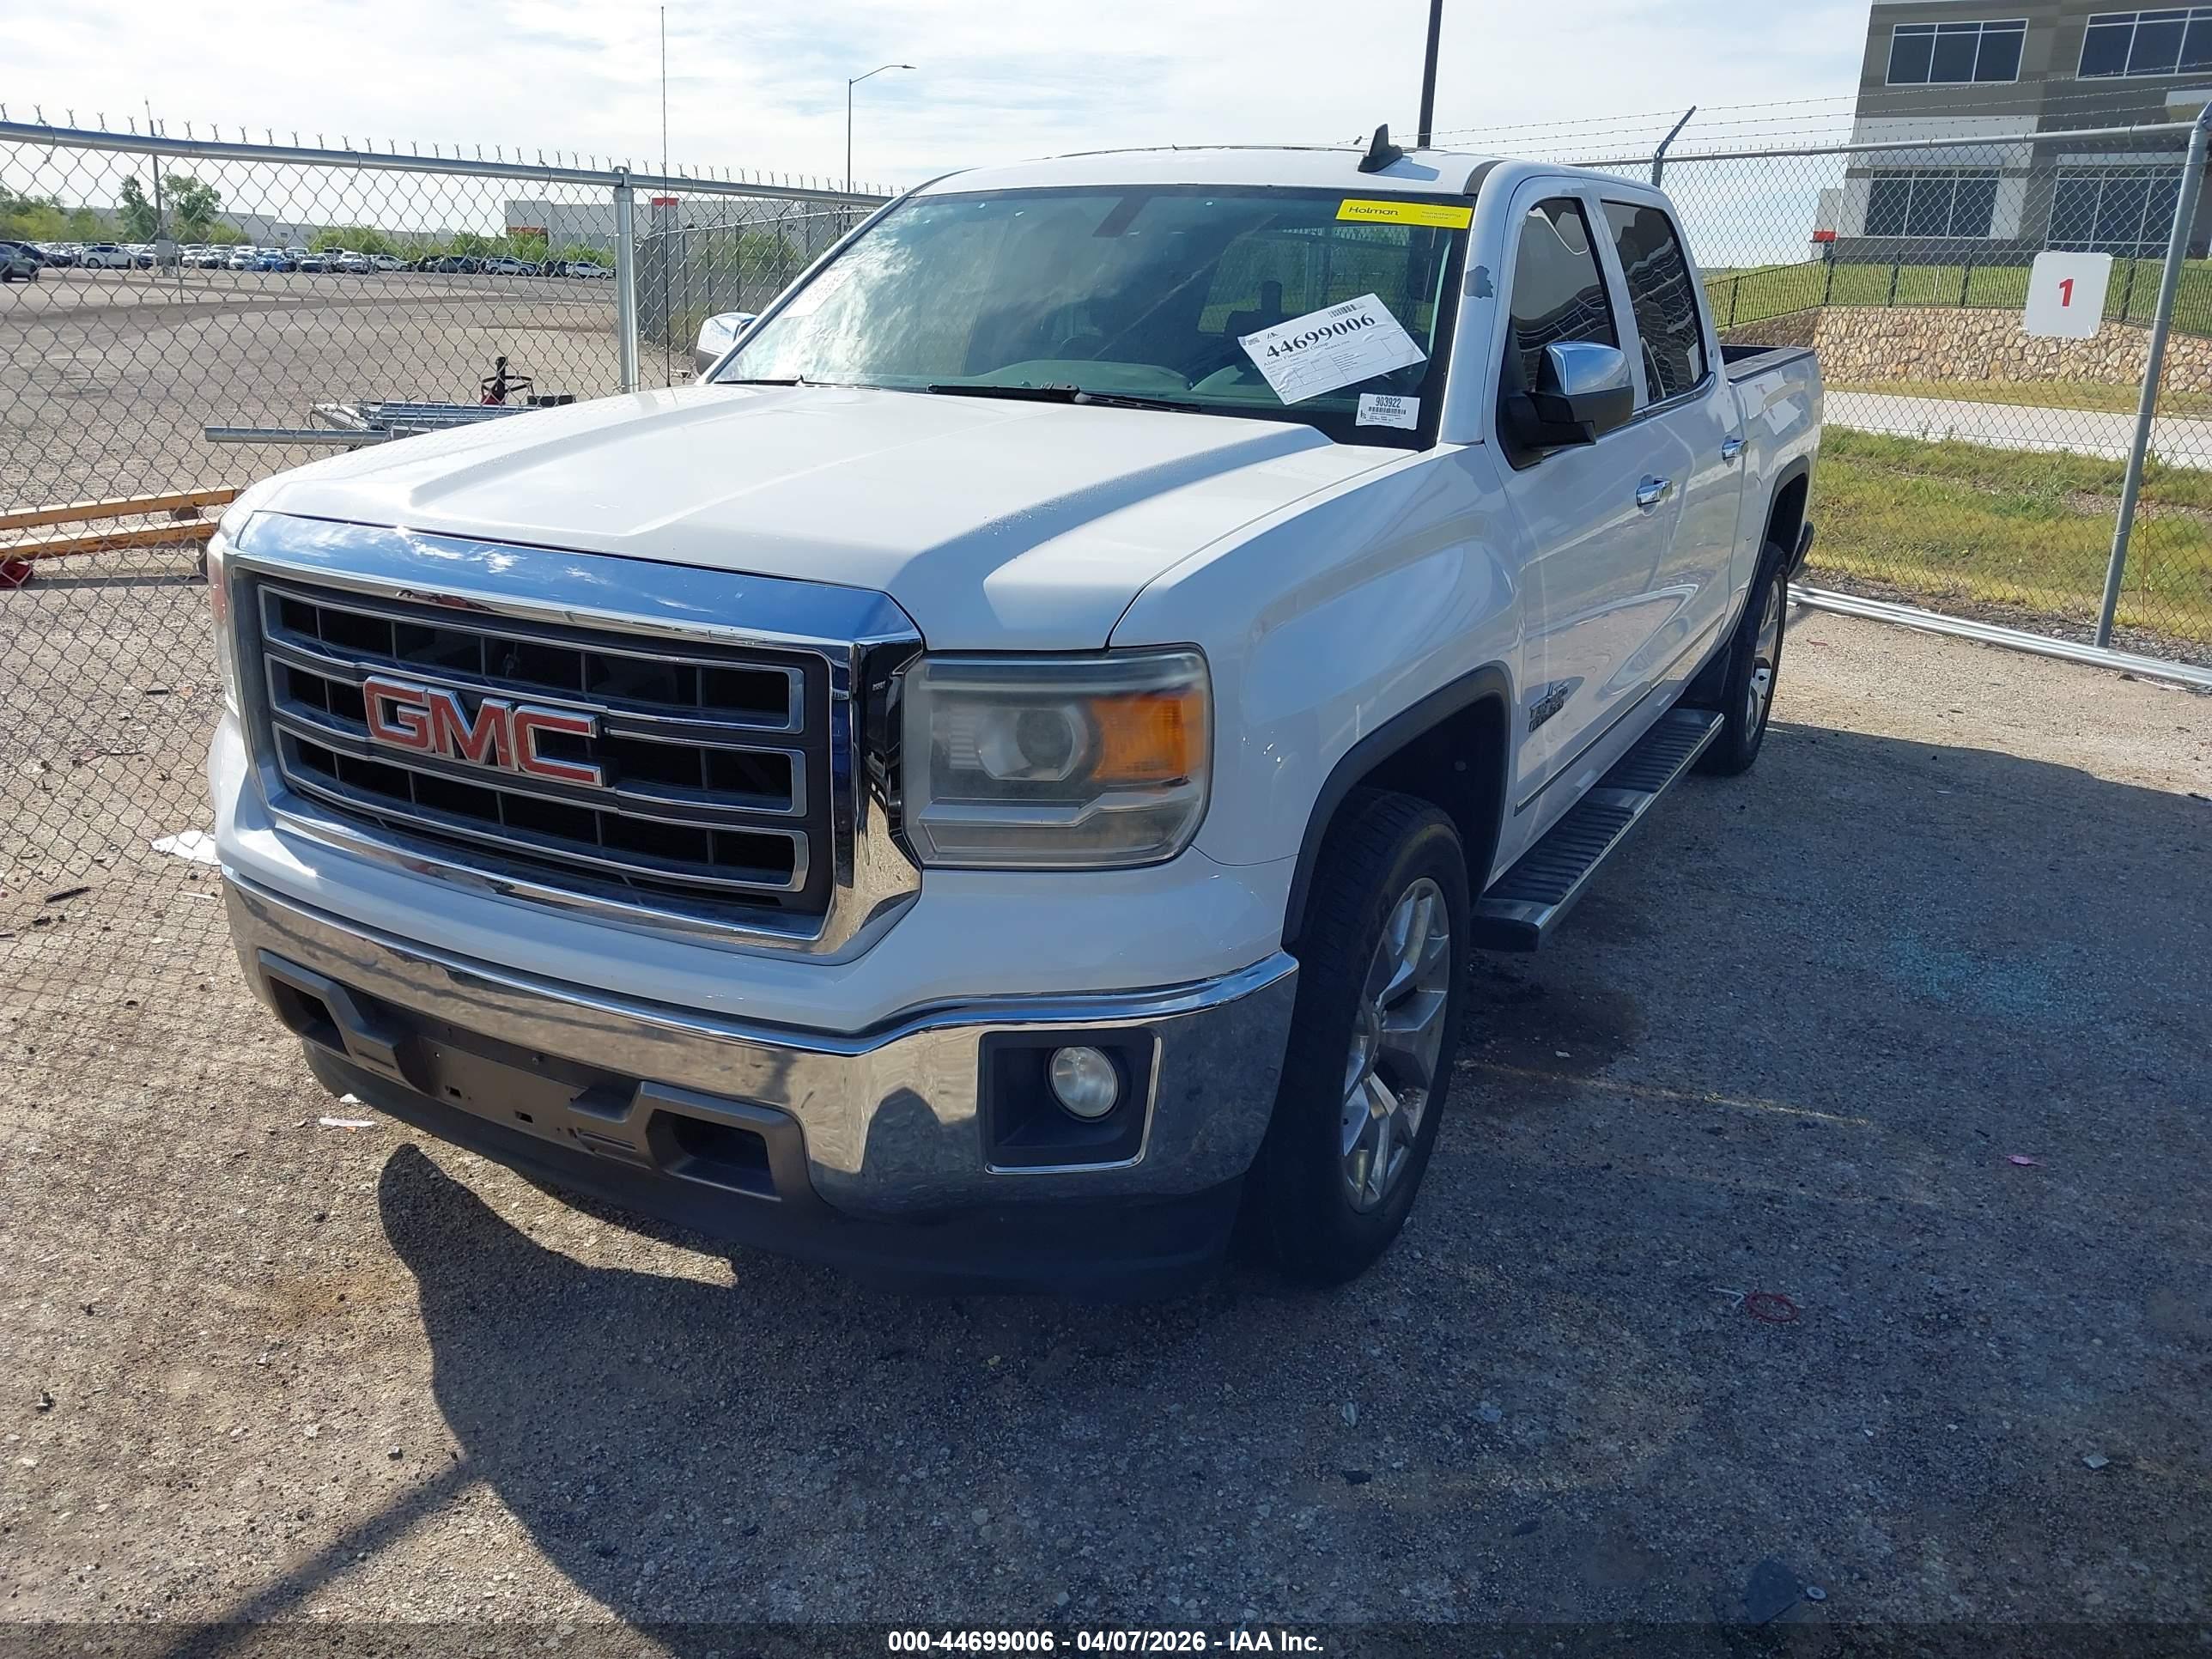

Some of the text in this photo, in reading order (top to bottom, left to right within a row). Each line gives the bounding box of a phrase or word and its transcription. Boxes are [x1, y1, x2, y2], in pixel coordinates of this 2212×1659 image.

[1348, 206, 1399, 216] Holman
[2058, 277, 2075, 307] 1
[1266, 313, 1376, 359] 44699006
[1375, 396, 1401, 409] 903922
[363, 675, 603, 787] GMC
